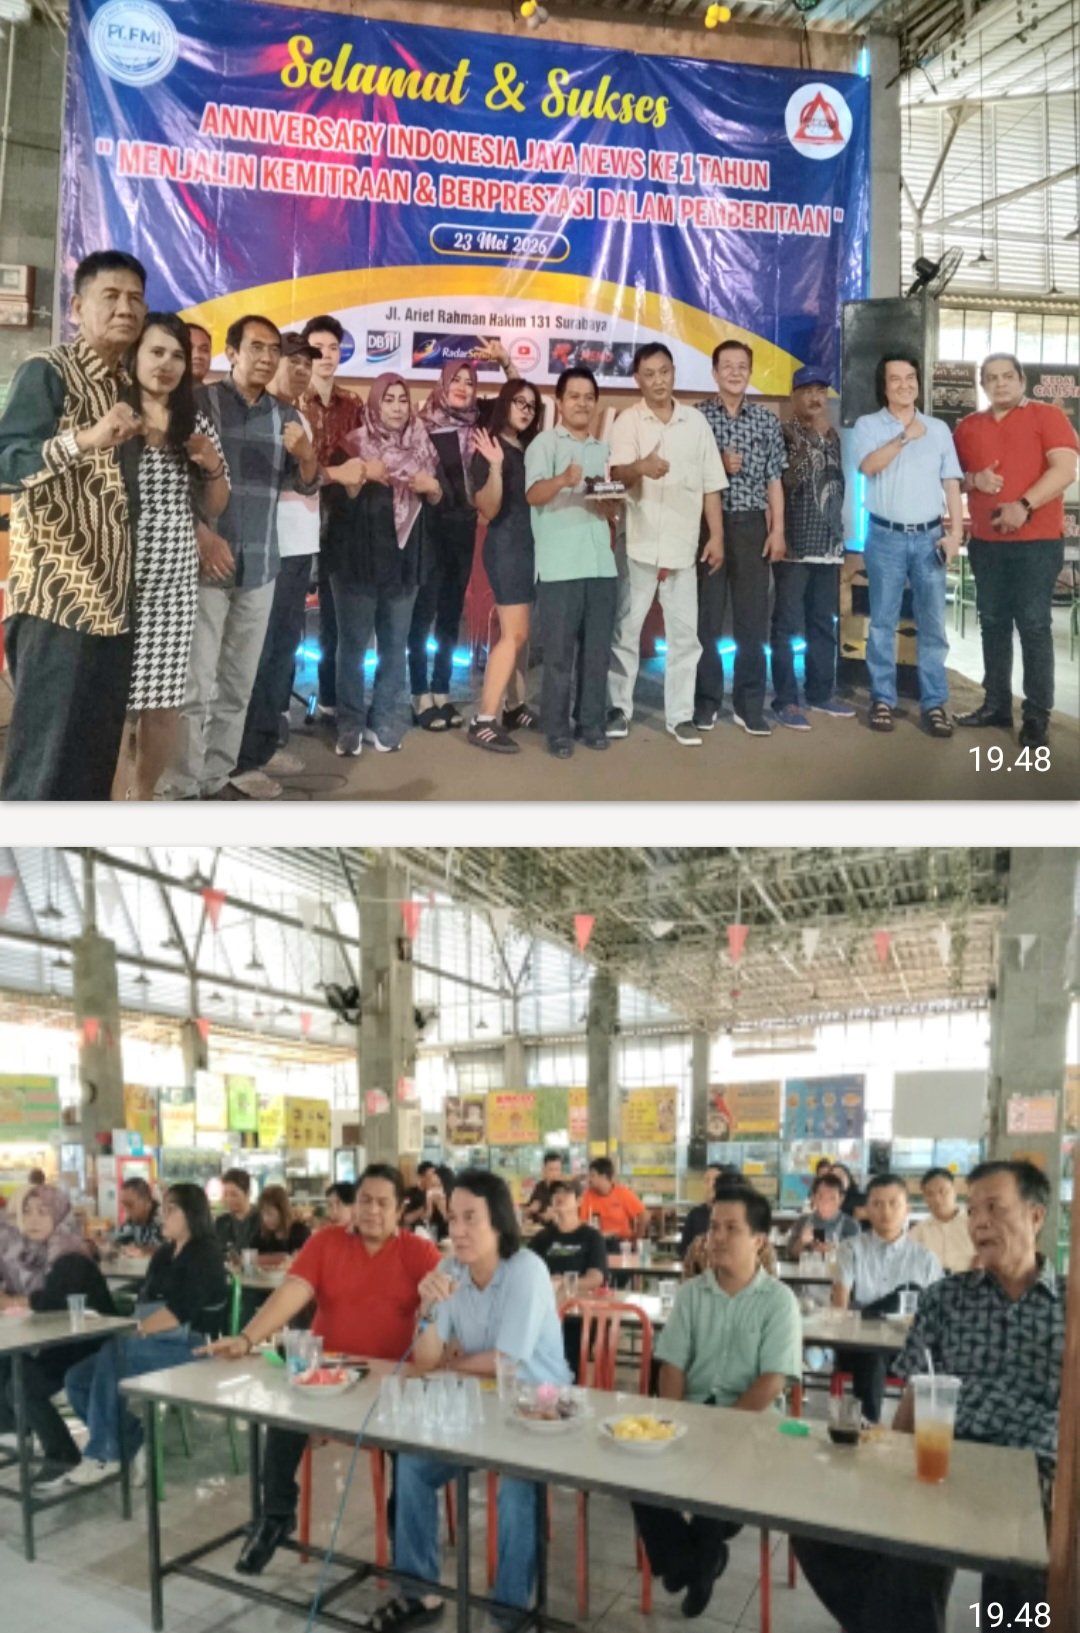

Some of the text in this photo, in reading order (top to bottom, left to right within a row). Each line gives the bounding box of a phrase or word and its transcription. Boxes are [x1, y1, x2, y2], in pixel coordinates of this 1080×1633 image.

[281, 35, 672, 128] Selamat & Sukses
[116, 139, 257, 190] MENJALIN
[260, 156, 412, 205] KEMITRAAN
[414, 173, 436, 207] &
[439, 174, 594, 220] BERPRESTASI
[597, 188, 675, 226] DALAM
[679, 196, 831, 237] PEMBERITAAN
[201, 102, 770, 191] ANNIVERSARY INDONESIA JAYA NEWS KE 1 TAHUN
[453, 233, 473, 251] 23
[476, 231, 509, 251] Mei
[385, 306, 607, 333] Jl. Arief Rahman Hakim 131 Surabaya
